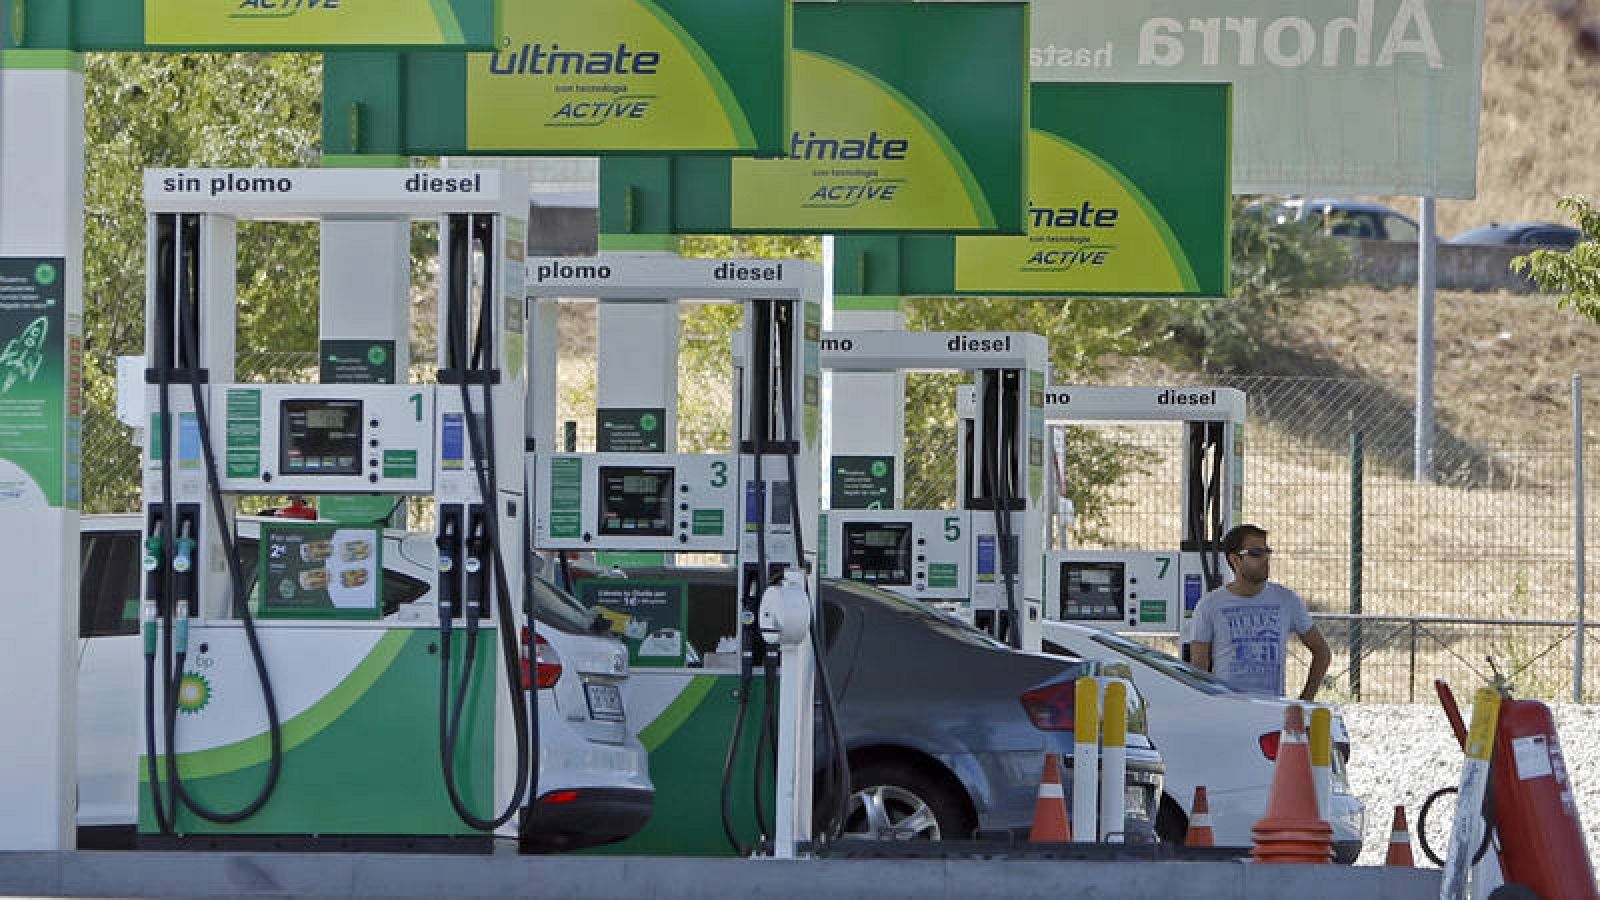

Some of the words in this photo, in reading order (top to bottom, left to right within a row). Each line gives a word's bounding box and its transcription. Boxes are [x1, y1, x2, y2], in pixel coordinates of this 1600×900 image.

[489, 43, 660, 75] ultimate
[554, 102, 649, 118] ACTIVE
[788, 131, 909, 160] timate
[163, 173, 201, 192] sin
[210, 173, 292, 196] plomo
[405, 172, 481, 192] diesel
[810, 185, 898, 200] ACTIVE
[1028, 201, 1119, 228] mate
[1028, 250, 1111, 264] ACTIVE
[538, 261, 611, 282] plomo
[713, 262, 783, 280] diesel
[821, 339, 853, 351] mo
[947, 335, 1011, 352] diesel
[409, 393, 423, 422] 1
[1157, 389, 1216, 405] diesel
[709, 461, 728, 488] 3
[943, 516, 961, 543] 5
[1155, 557, 1171, 580] 7
